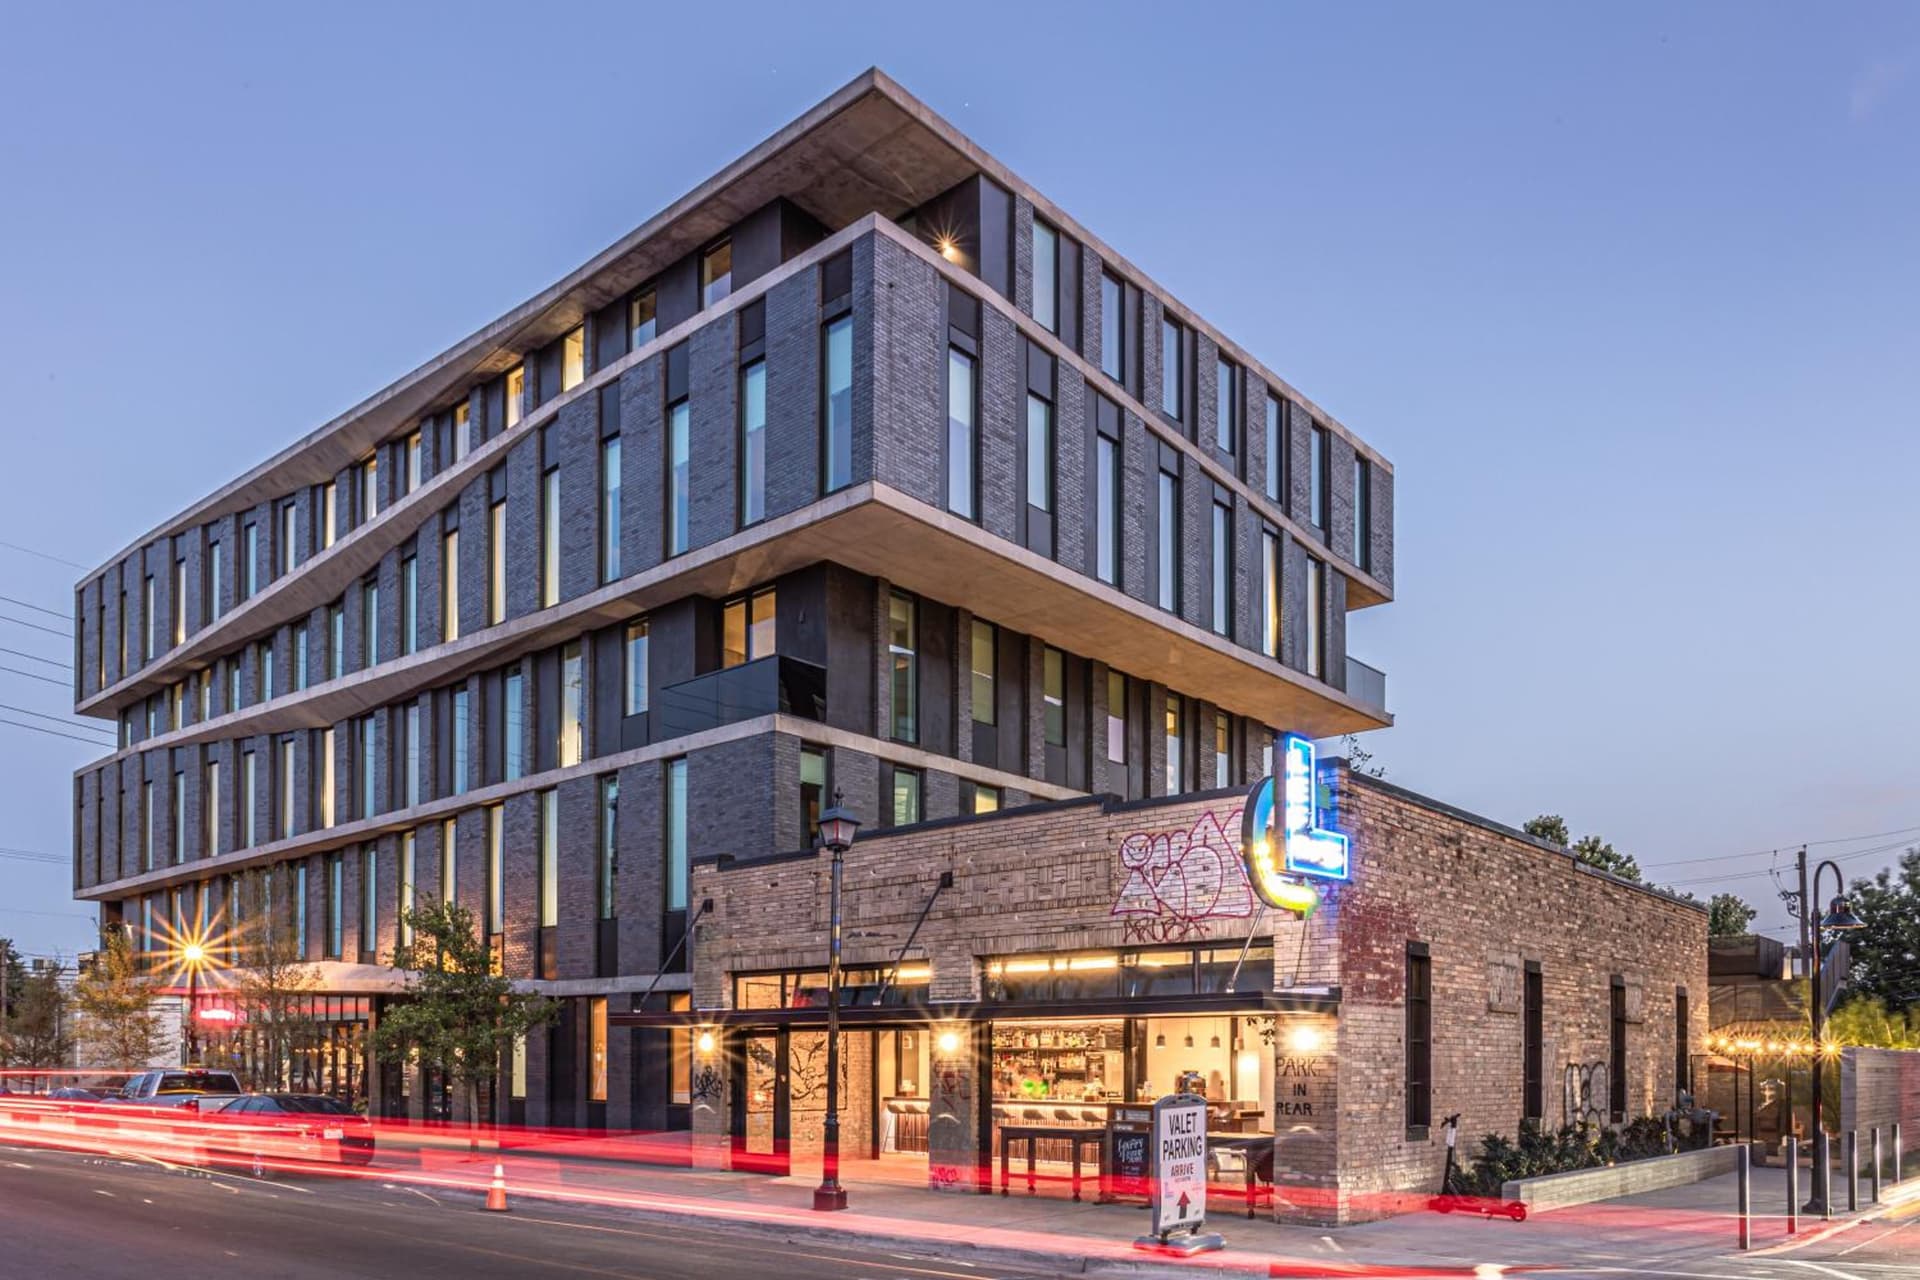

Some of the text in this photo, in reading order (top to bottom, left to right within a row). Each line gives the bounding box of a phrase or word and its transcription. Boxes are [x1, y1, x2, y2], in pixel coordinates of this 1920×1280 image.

[1275, 1057, 1317, 1077] PARK
[1293, 1083, 1307, 1097] IN
[1276, 1102, 1313, 1117] REAR
[1168, 1112, 1198, 1136] VALET
[1163, 1135, 1203, 1161] PARKING
[1171, 1162, 1194, 1177] ARRIVE
